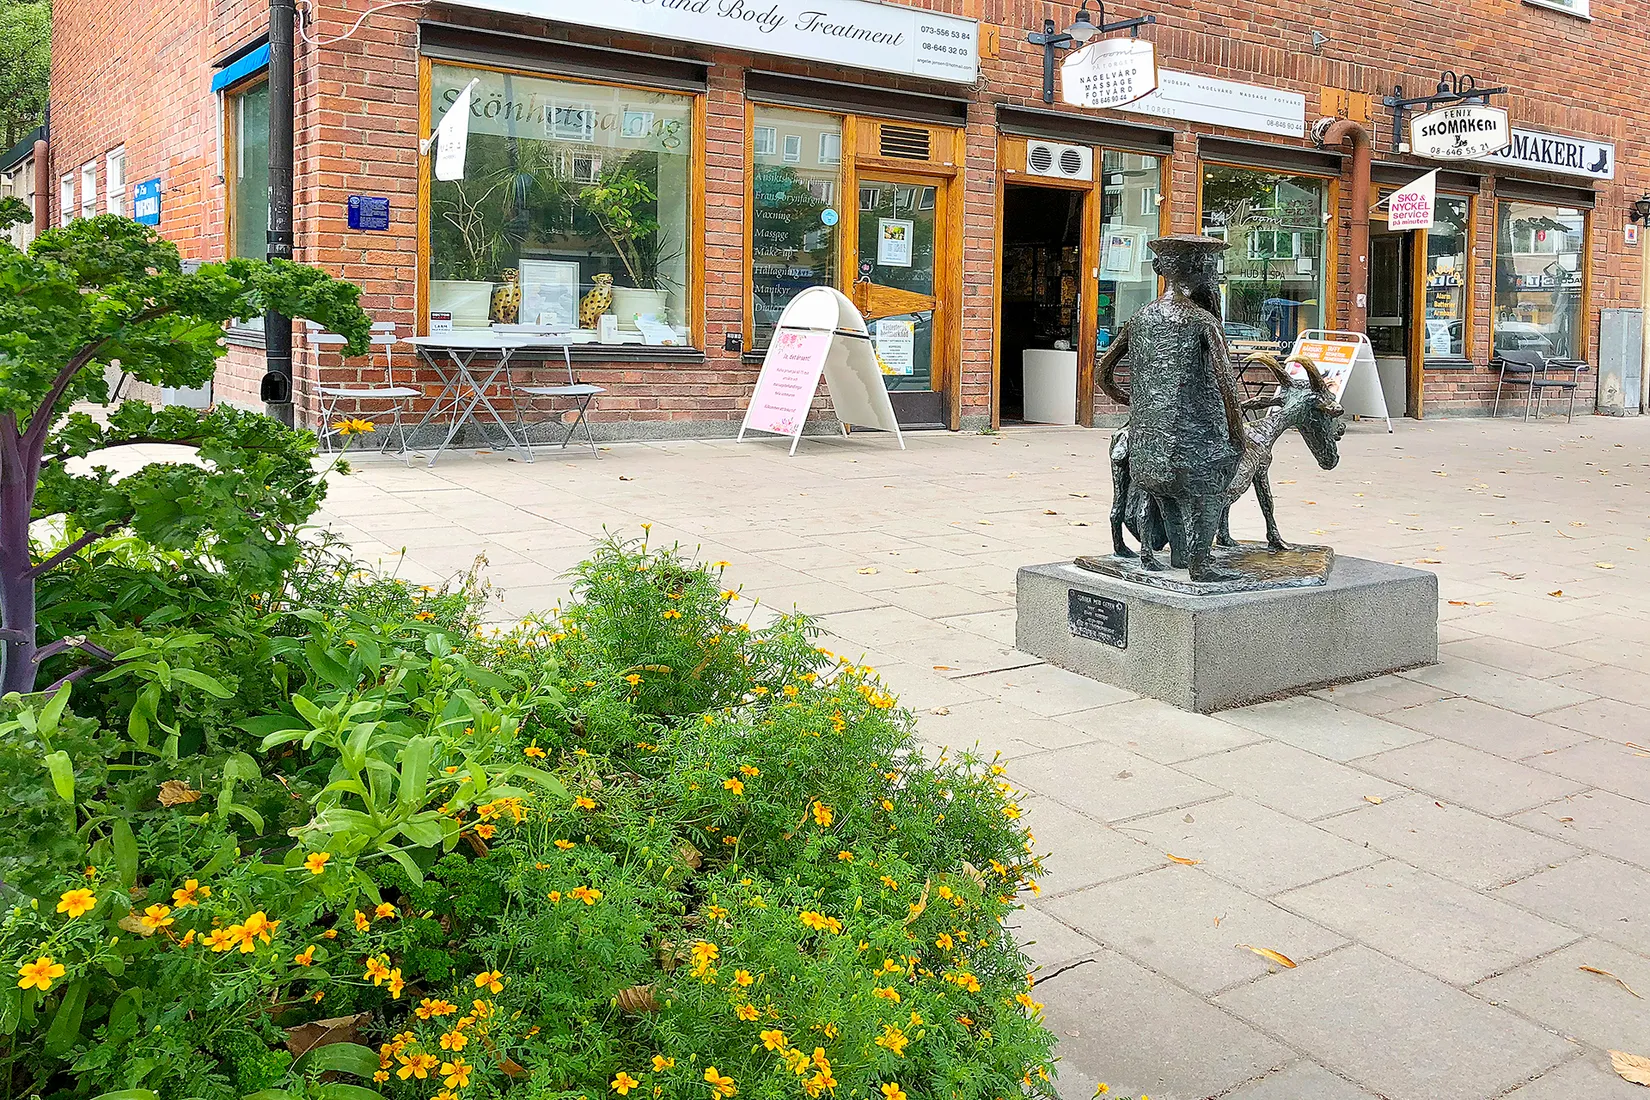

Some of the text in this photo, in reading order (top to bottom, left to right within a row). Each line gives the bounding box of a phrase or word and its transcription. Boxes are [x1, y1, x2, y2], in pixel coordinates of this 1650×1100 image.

[717, 0, 786, 33] Body
[795, 11, 904, 46] Treatment
[921, 26, 970, 40] 073-556 53 84
[922, 42, 968, 56] 08-646 32 03
[1103, 59, 1134, 69] TORGET
[1079, 68, 1137, 84] NAGELVÅRD
[1085, 77, 1132, 91] MASSAGE
[1085, 85, 1133, 99] FOTVÅRD
[1197, 84, 1233, 95] NAGELVÅRD
[1239, 91, 1267, 101] MASSAGE
[1100, 96, 1111, 104] 646
[1131, 102, 1176, 116] PÅ TORGET
[1443, 109, 1472, 119] FENIX
[1421, 118, 1497, 137] SKOMAKERI
[1430, 143, 1489, 156] 08-646 55 21
[1397, 193, 1418, 202] SKO
[1391, 201, 1431, 211] NYCKEL
[755, 209, 791, 223] Vaxning
[1393, 210, 1429, 219] service
[754, 228, 789, 242] Massage
[754, 265, 801, 279] Håltagning
[1240, 267, 1259, 279] HUD
[1269, 270, 1285, 280] SPA
[754, 284, 791, 297] Manikyr
